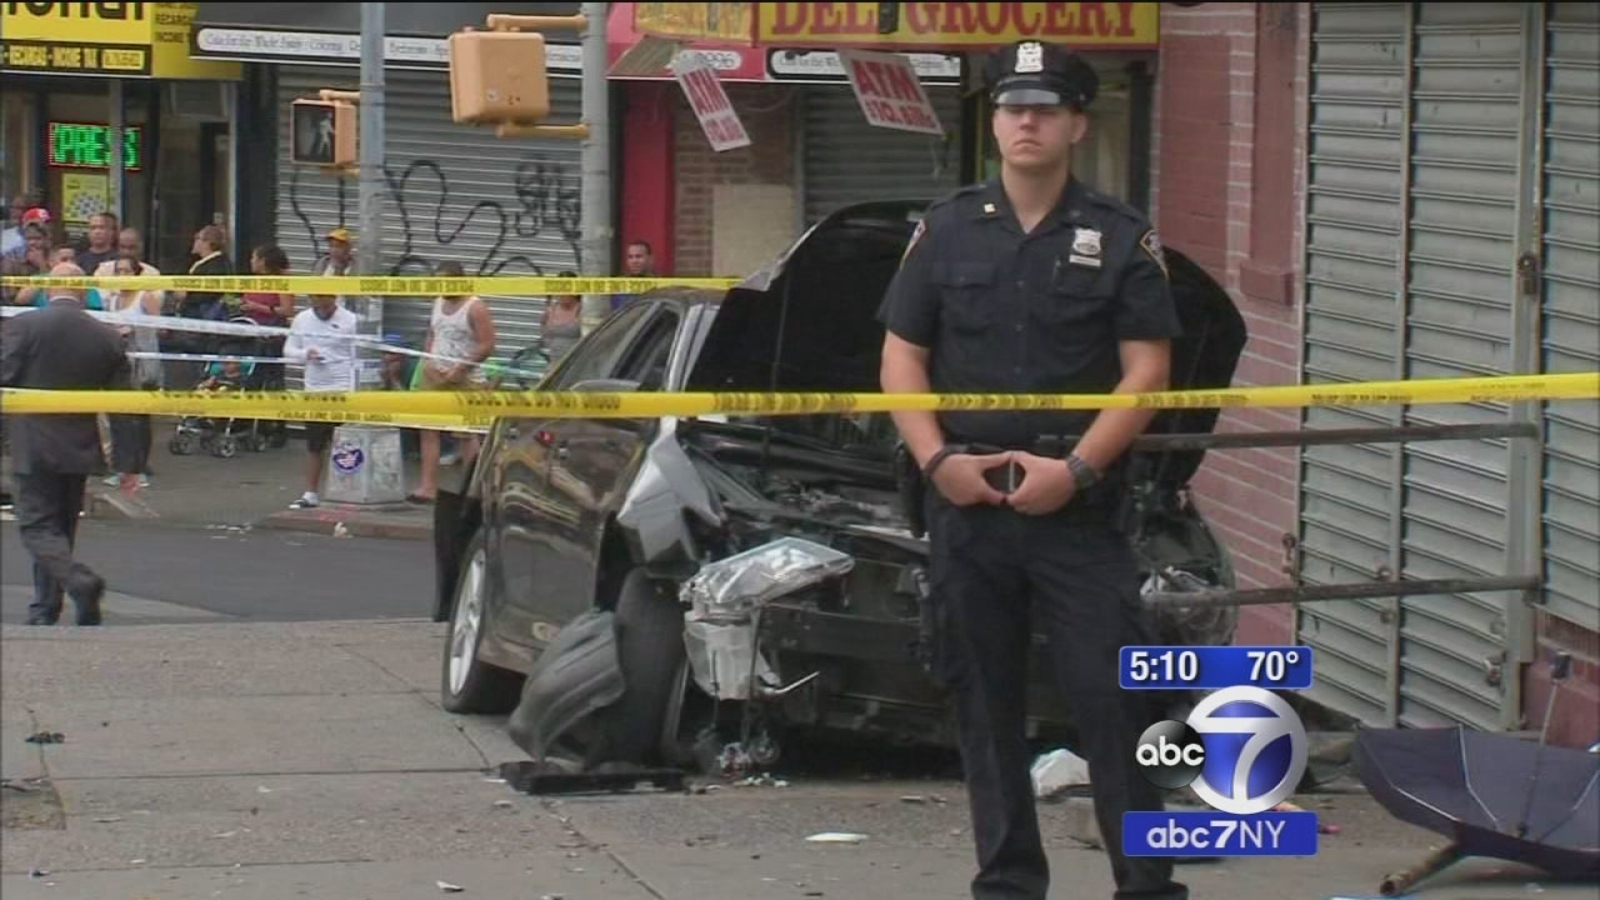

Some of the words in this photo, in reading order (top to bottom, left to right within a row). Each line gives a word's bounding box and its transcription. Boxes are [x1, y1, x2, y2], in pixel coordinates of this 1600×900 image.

[772, 3, 880, 35] DEL
[905, 3, 1135, 37] GROCERY
[852, 60, 924, 104] ATM
